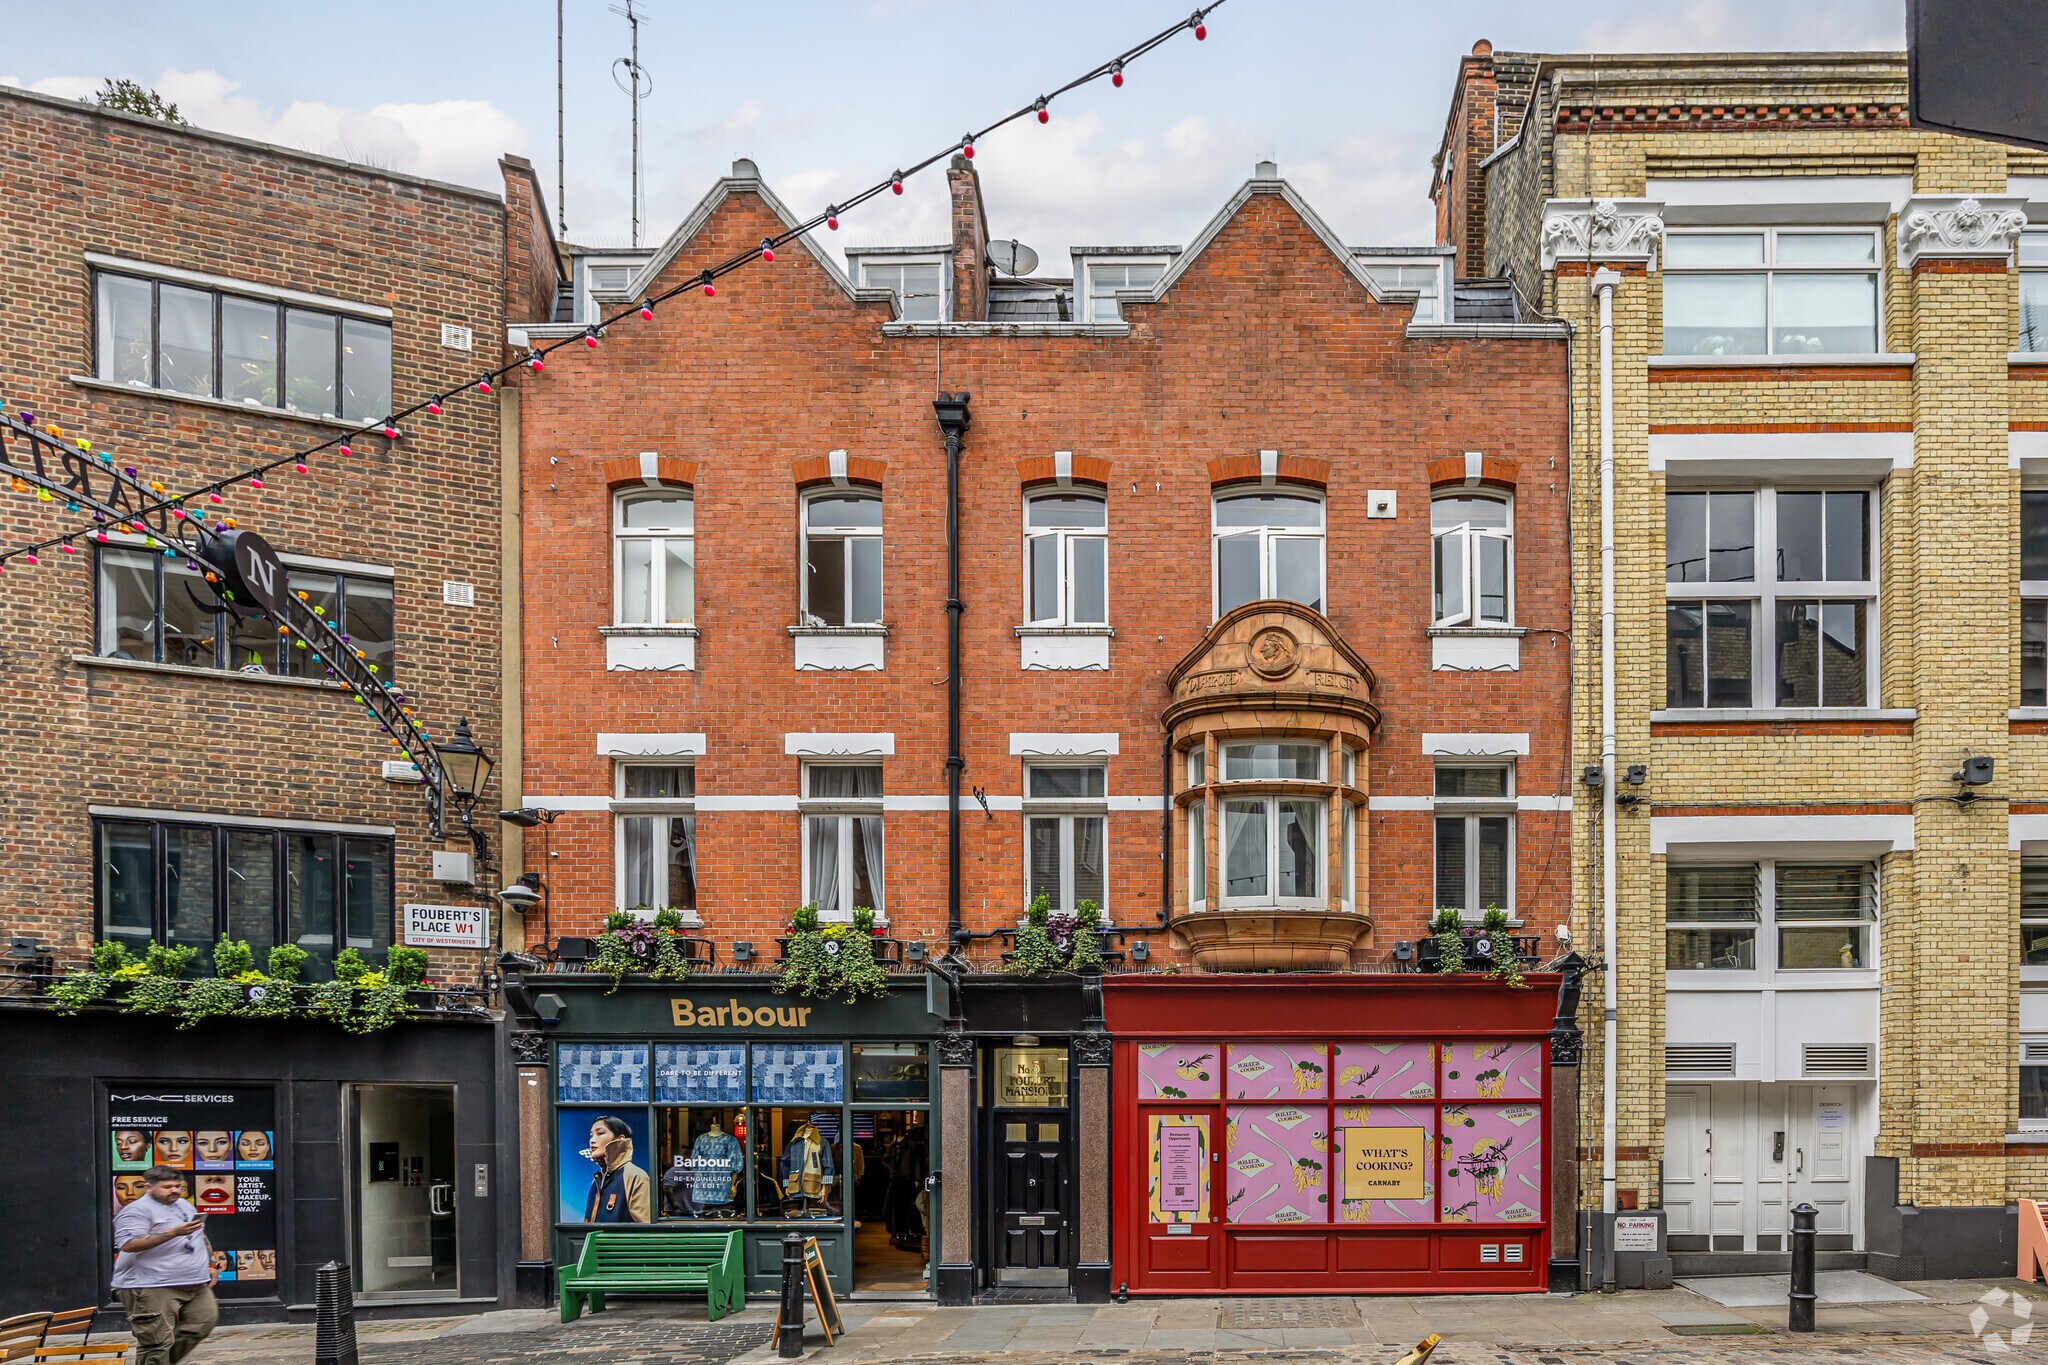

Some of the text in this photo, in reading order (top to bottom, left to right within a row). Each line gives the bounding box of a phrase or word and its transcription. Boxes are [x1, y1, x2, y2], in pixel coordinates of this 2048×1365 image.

[246, 546, 277, 596] N
[412, 908, 480, 922] FOUBERT'S
[412, 921, 474, 934] PLACE W1
[671, 998, 811, 1027] Barbour
[1005, 1087, 1056, 1096] MANSIO
[1362, 1149, 1408, 1157] WHAT'S
[1356, 1162, 1413, 1170] COOKING?
[714, 1290, 726, 1311] Q
